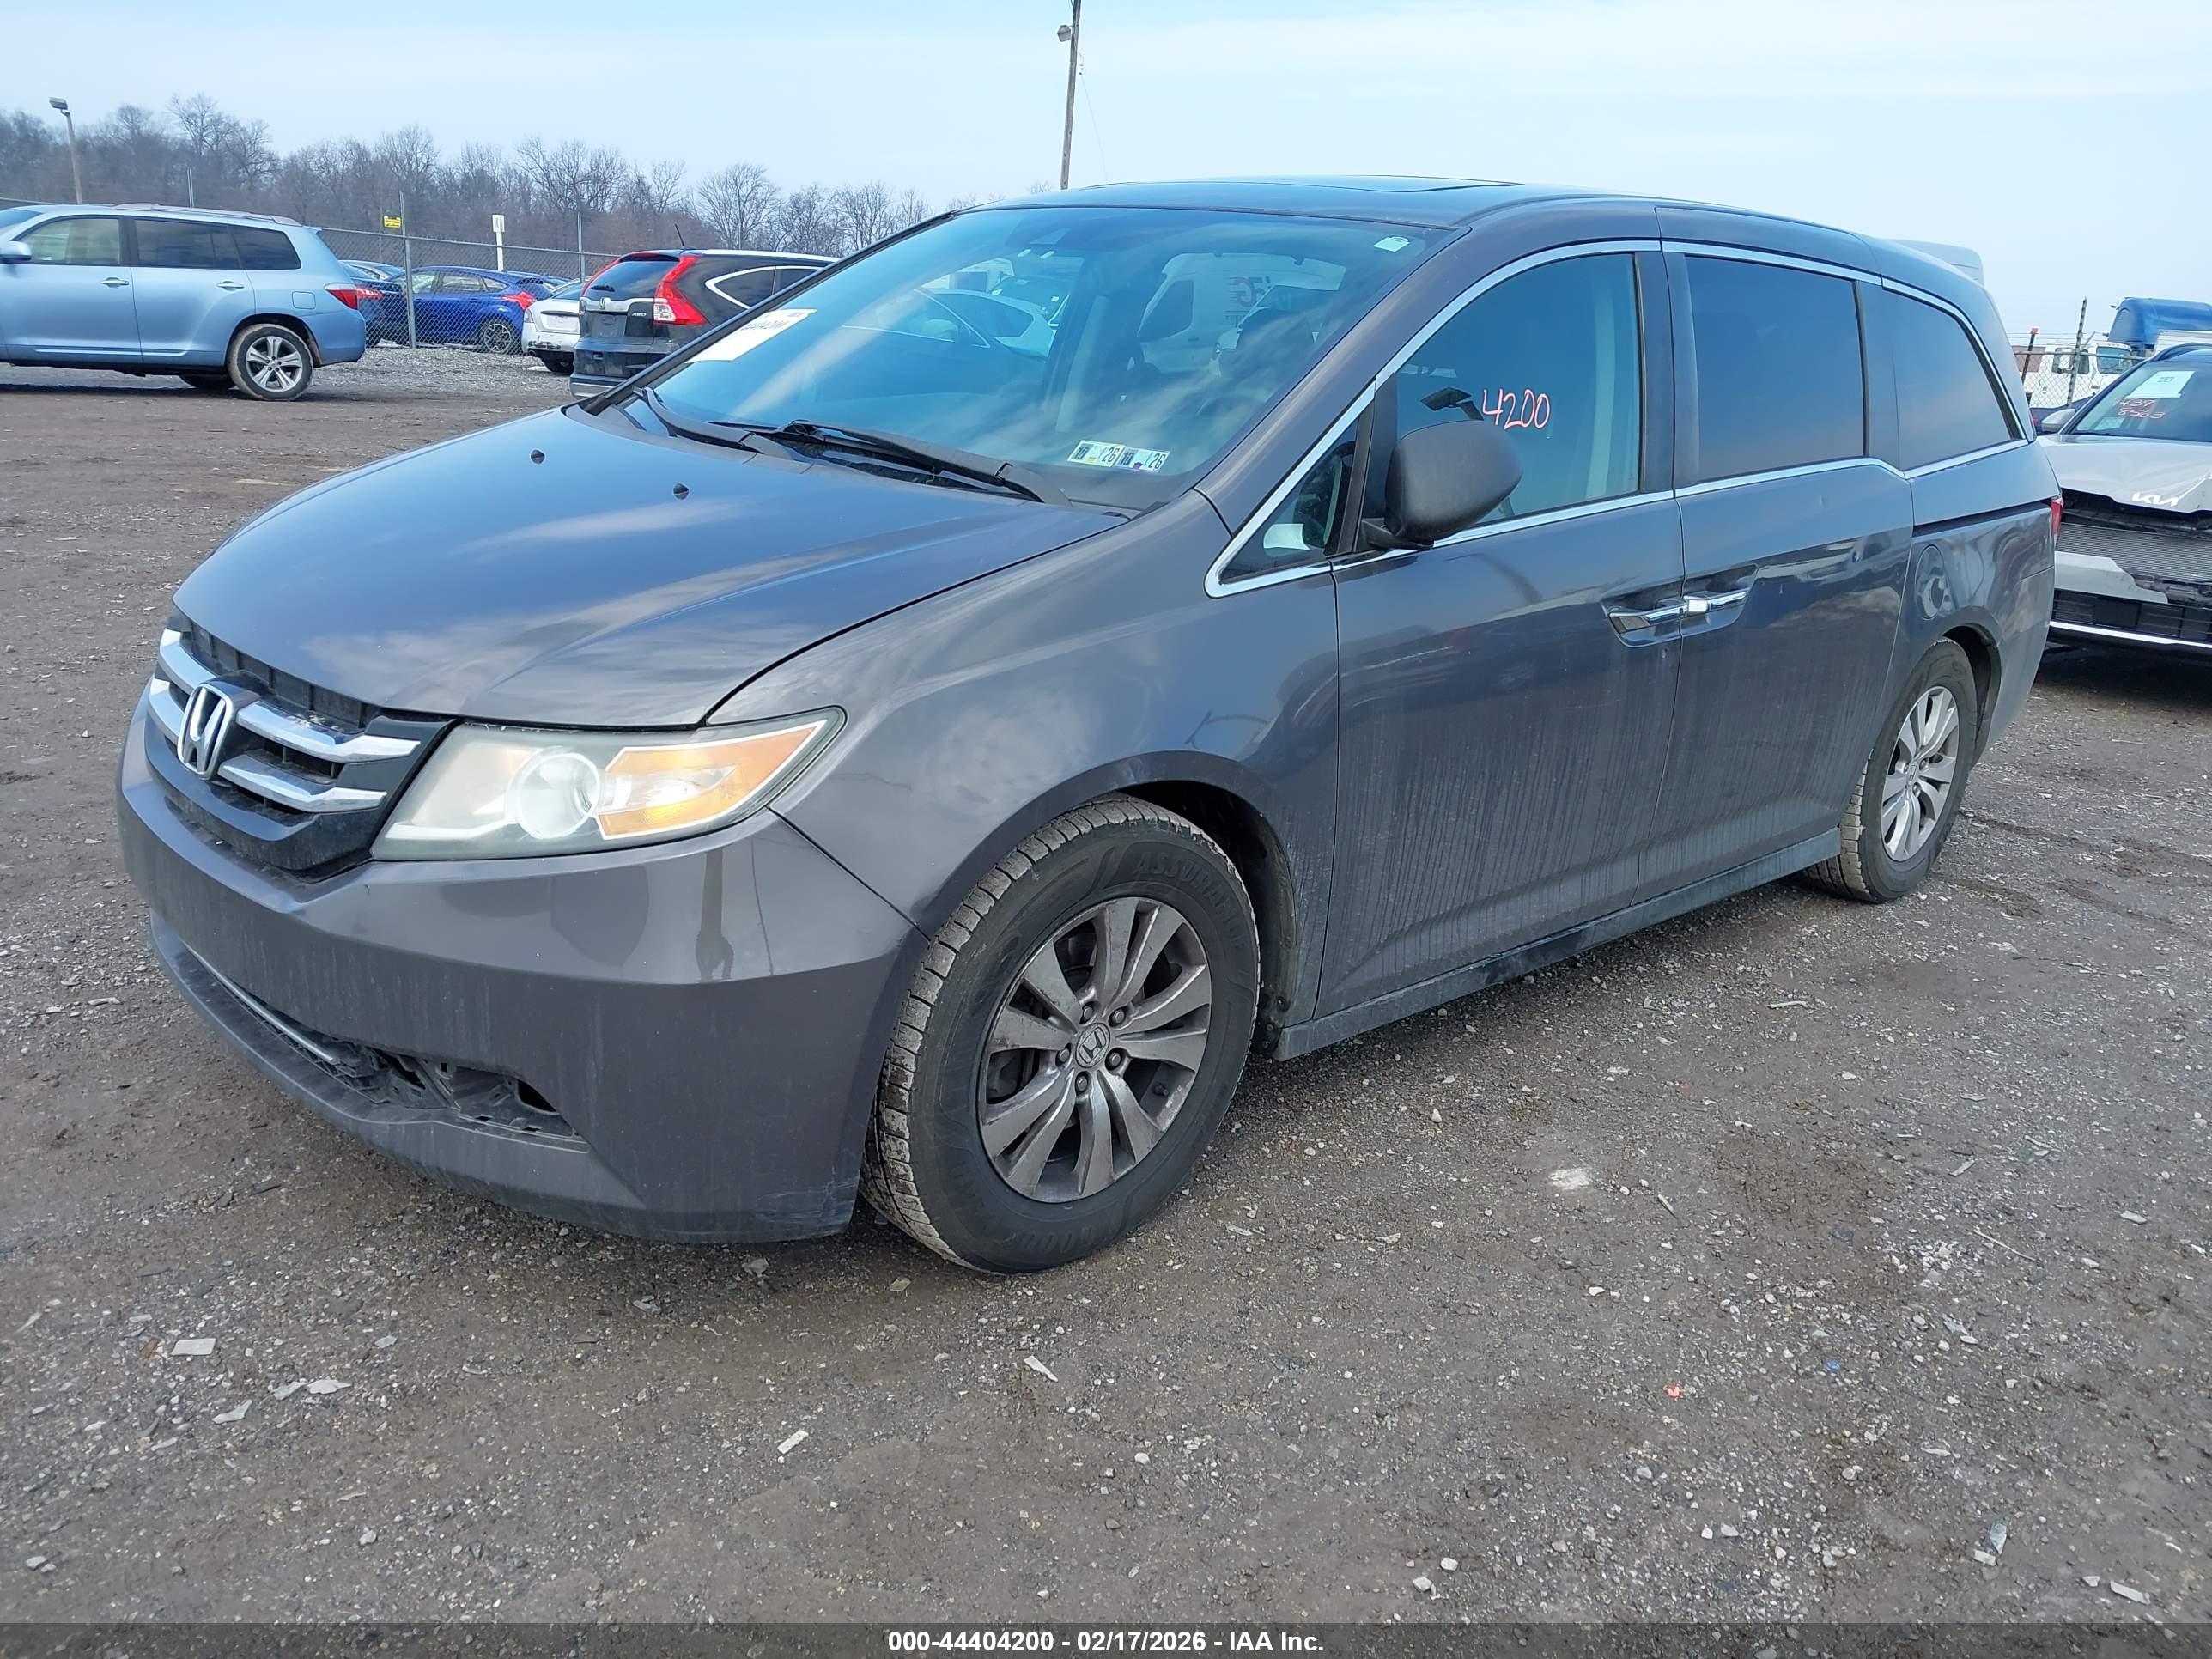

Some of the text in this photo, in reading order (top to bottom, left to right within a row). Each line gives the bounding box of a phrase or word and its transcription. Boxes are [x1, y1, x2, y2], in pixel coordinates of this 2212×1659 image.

[1482, 388, 1550, 430] 4200
[1102, 447, 1120, 463] 26
[1148, 453, 1166, 469] 26
